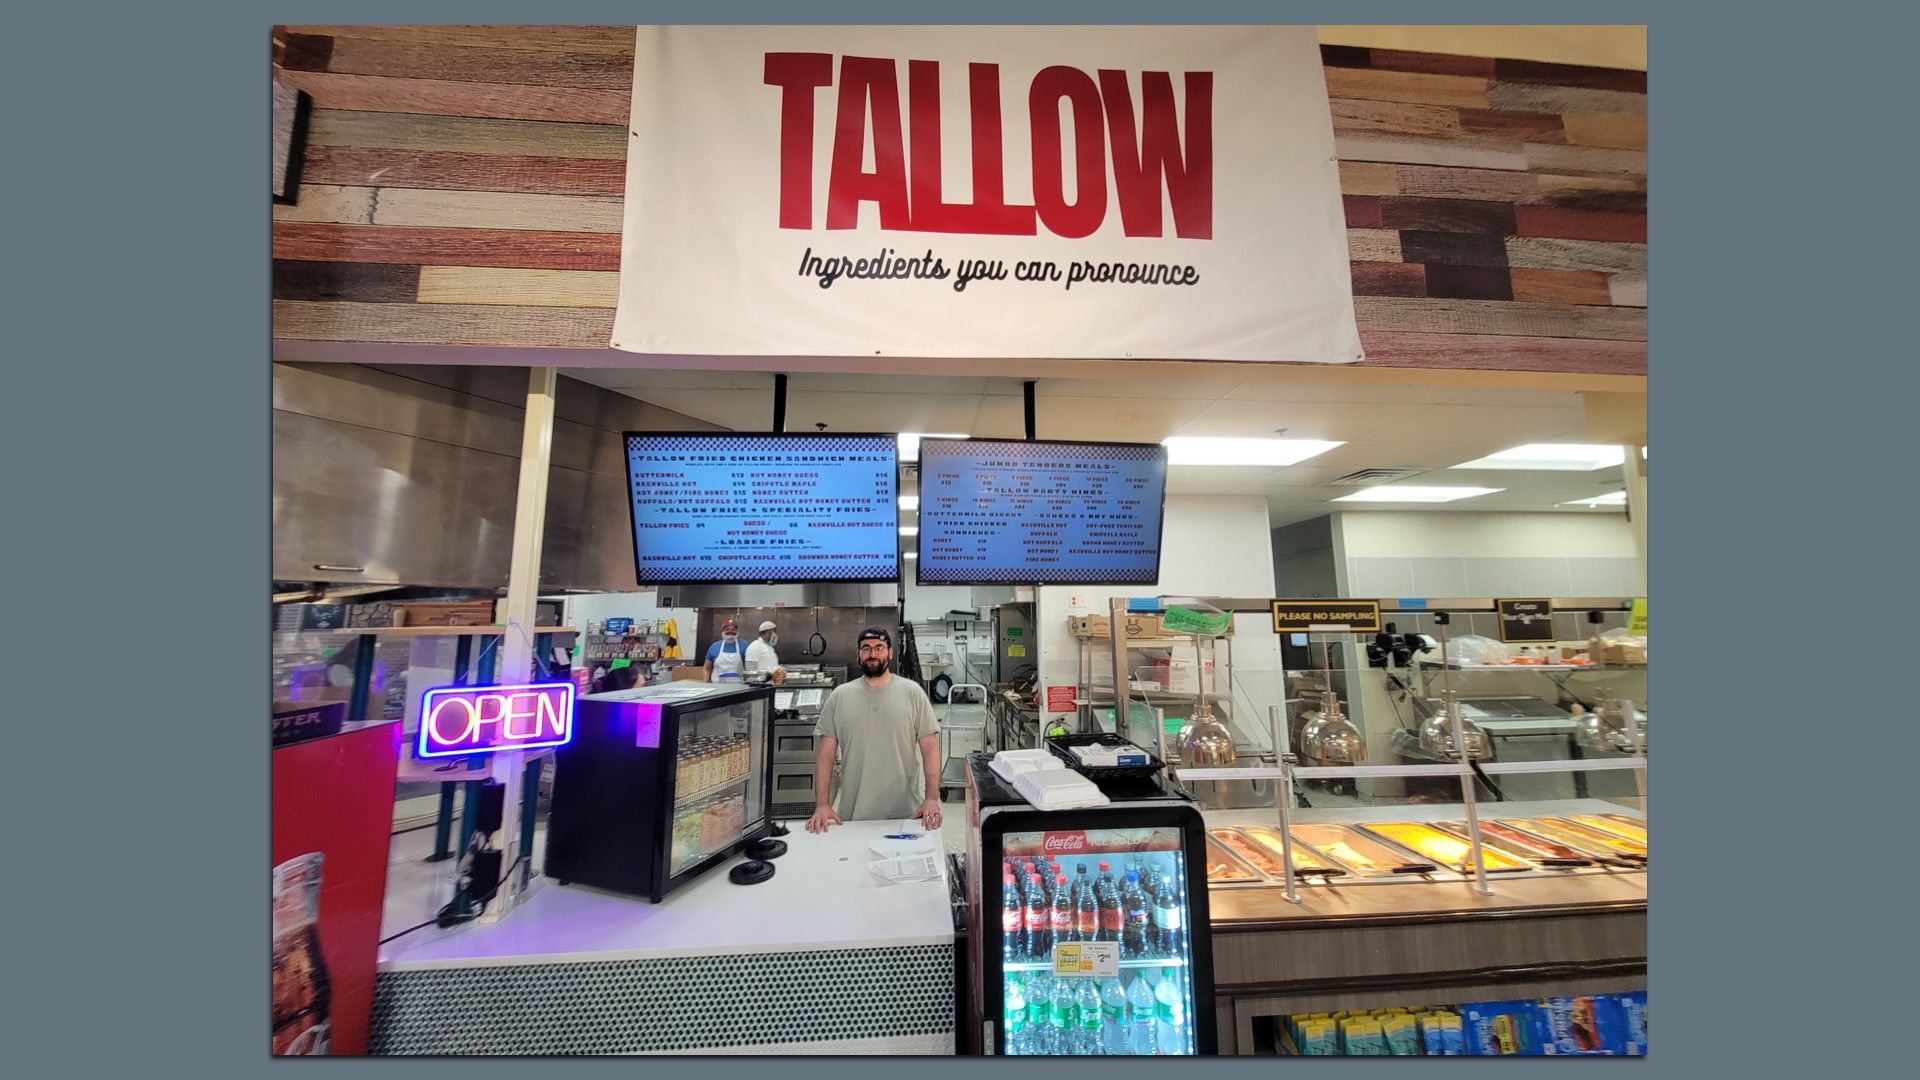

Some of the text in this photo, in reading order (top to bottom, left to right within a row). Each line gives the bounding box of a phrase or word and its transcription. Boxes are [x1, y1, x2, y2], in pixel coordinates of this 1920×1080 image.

[764, 52, 1213, 240] TALLOW
[798, 247, 1200, 291] Ingredients you can pronounce
[1279, 612, 1375, 620] PLEASE NO SAMPLING
[428, 690, 567, 746] OPEN
[1045, 834, 1086, 851] Coca-Cola
